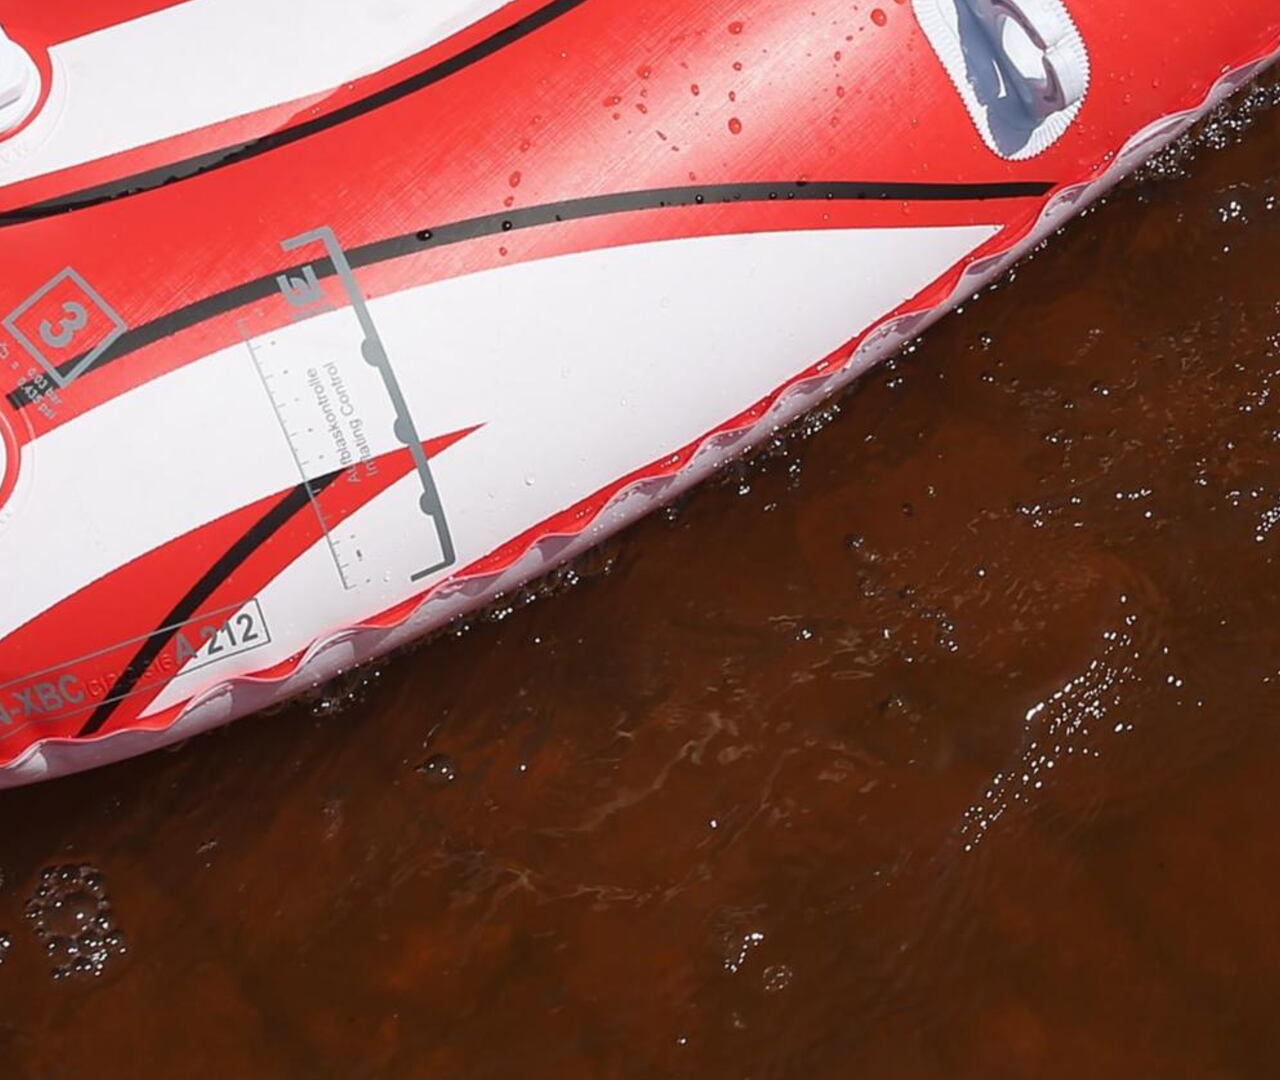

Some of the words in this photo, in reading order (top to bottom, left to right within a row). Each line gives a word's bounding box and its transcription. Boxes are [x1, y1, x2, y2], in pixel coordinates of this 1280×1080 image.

[40, 301, 88, 349] 3
[323, 361, 355, 416] Control
[307, 367, 361, 483] Aufblaskontrolle
[349, 418, 380, 477] Inflating
[175, 632, 199, 663] A
[201, 612, 259, 656] 212
